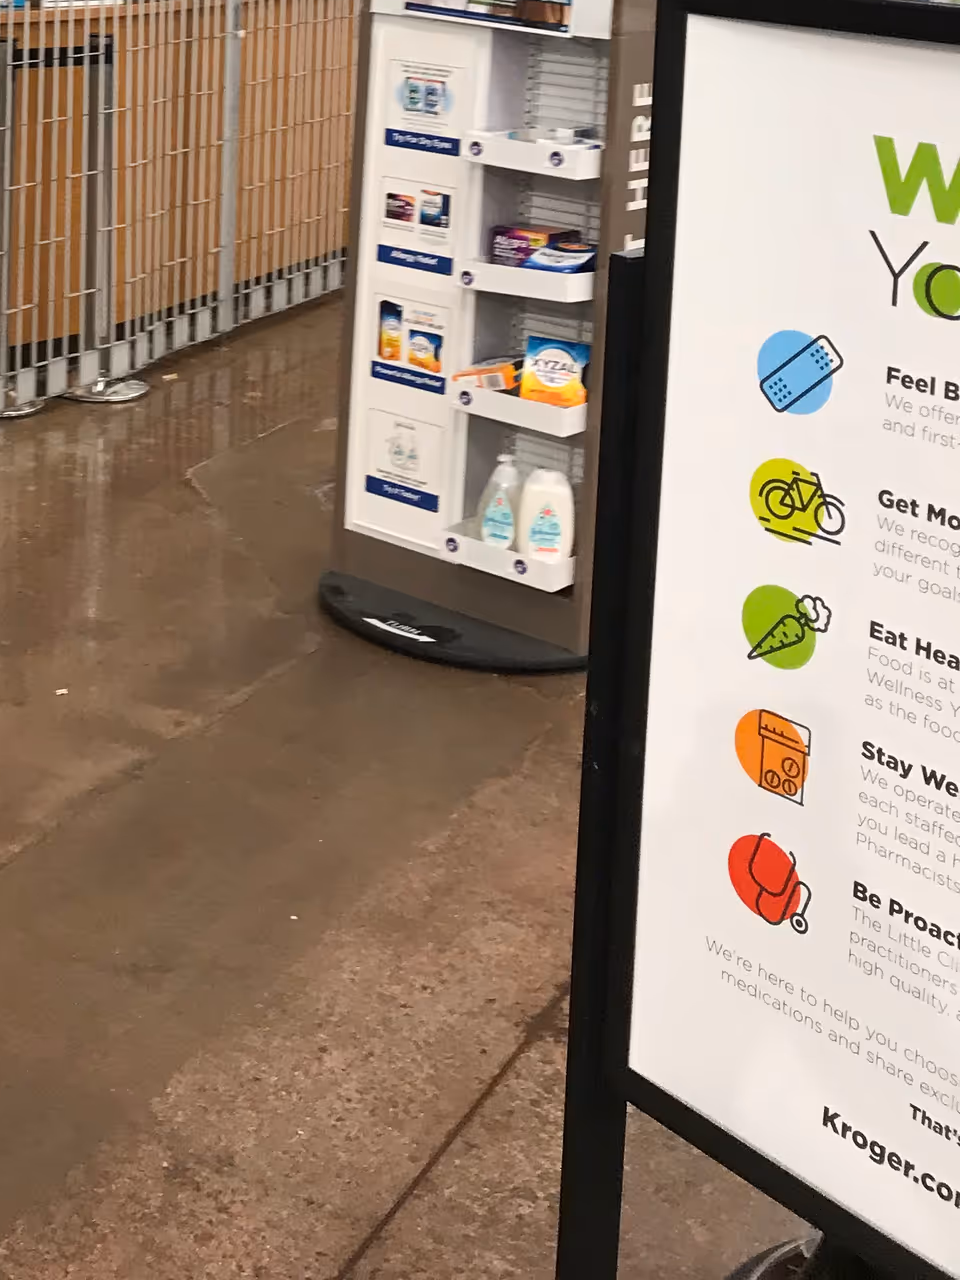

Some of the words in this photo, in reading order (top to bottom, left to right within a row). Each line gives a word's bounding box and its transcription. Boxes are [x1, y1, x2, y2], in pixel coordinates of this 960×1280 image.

[886, 366, 936, 396] Feel
[885, 392, 913, 413] We
[882, 418, 916, 437] and
[878, 489, 920, 518] Get
[877, 514, 905, 536] We
[874, 537, 950, 576] different
[873, 562, 913, 584] your
[869, 619, 908, 651] Eat
[868, 646, 913, 676] Food
[919, 666, 932, 684] is
[937, 677, 955, 694] at
[867, 668, 943, 712] Wellness
[864, 693, 883, 710] as
[889, 700, 917, 724] the
[860, 765, 888, 789] We
[861, 740, 914, 779] Stay
[921, 764, 959, 797] We
[858, 790, 899, 818] each
[857, 813, 888, 836] you
[894, 826, 930, 856] lead
[936, 850, 946, 864] a
[856, 831, 960, 894] Pharmacists
[853, 880, 881, 909] Be
[852, 905, 882, 932] The
[888, 924, 932, 959] Little
[848, 948, 885, 980] high
[849, 930, 958, 996] practitioners
[705, 935, 753, 972] We're
[758, 963, 795, 995] here
[800, 987, 818, 1007] to
[823, 998, 860, 1031] help
[865, 1024, 898, 1053] you
[721, 969, 823, 1035] medications
[828, 1028, 861, 1056] and
[866, 1049, 914, 1086] share
[822, 1105, 960, 1209] Kroger.co
